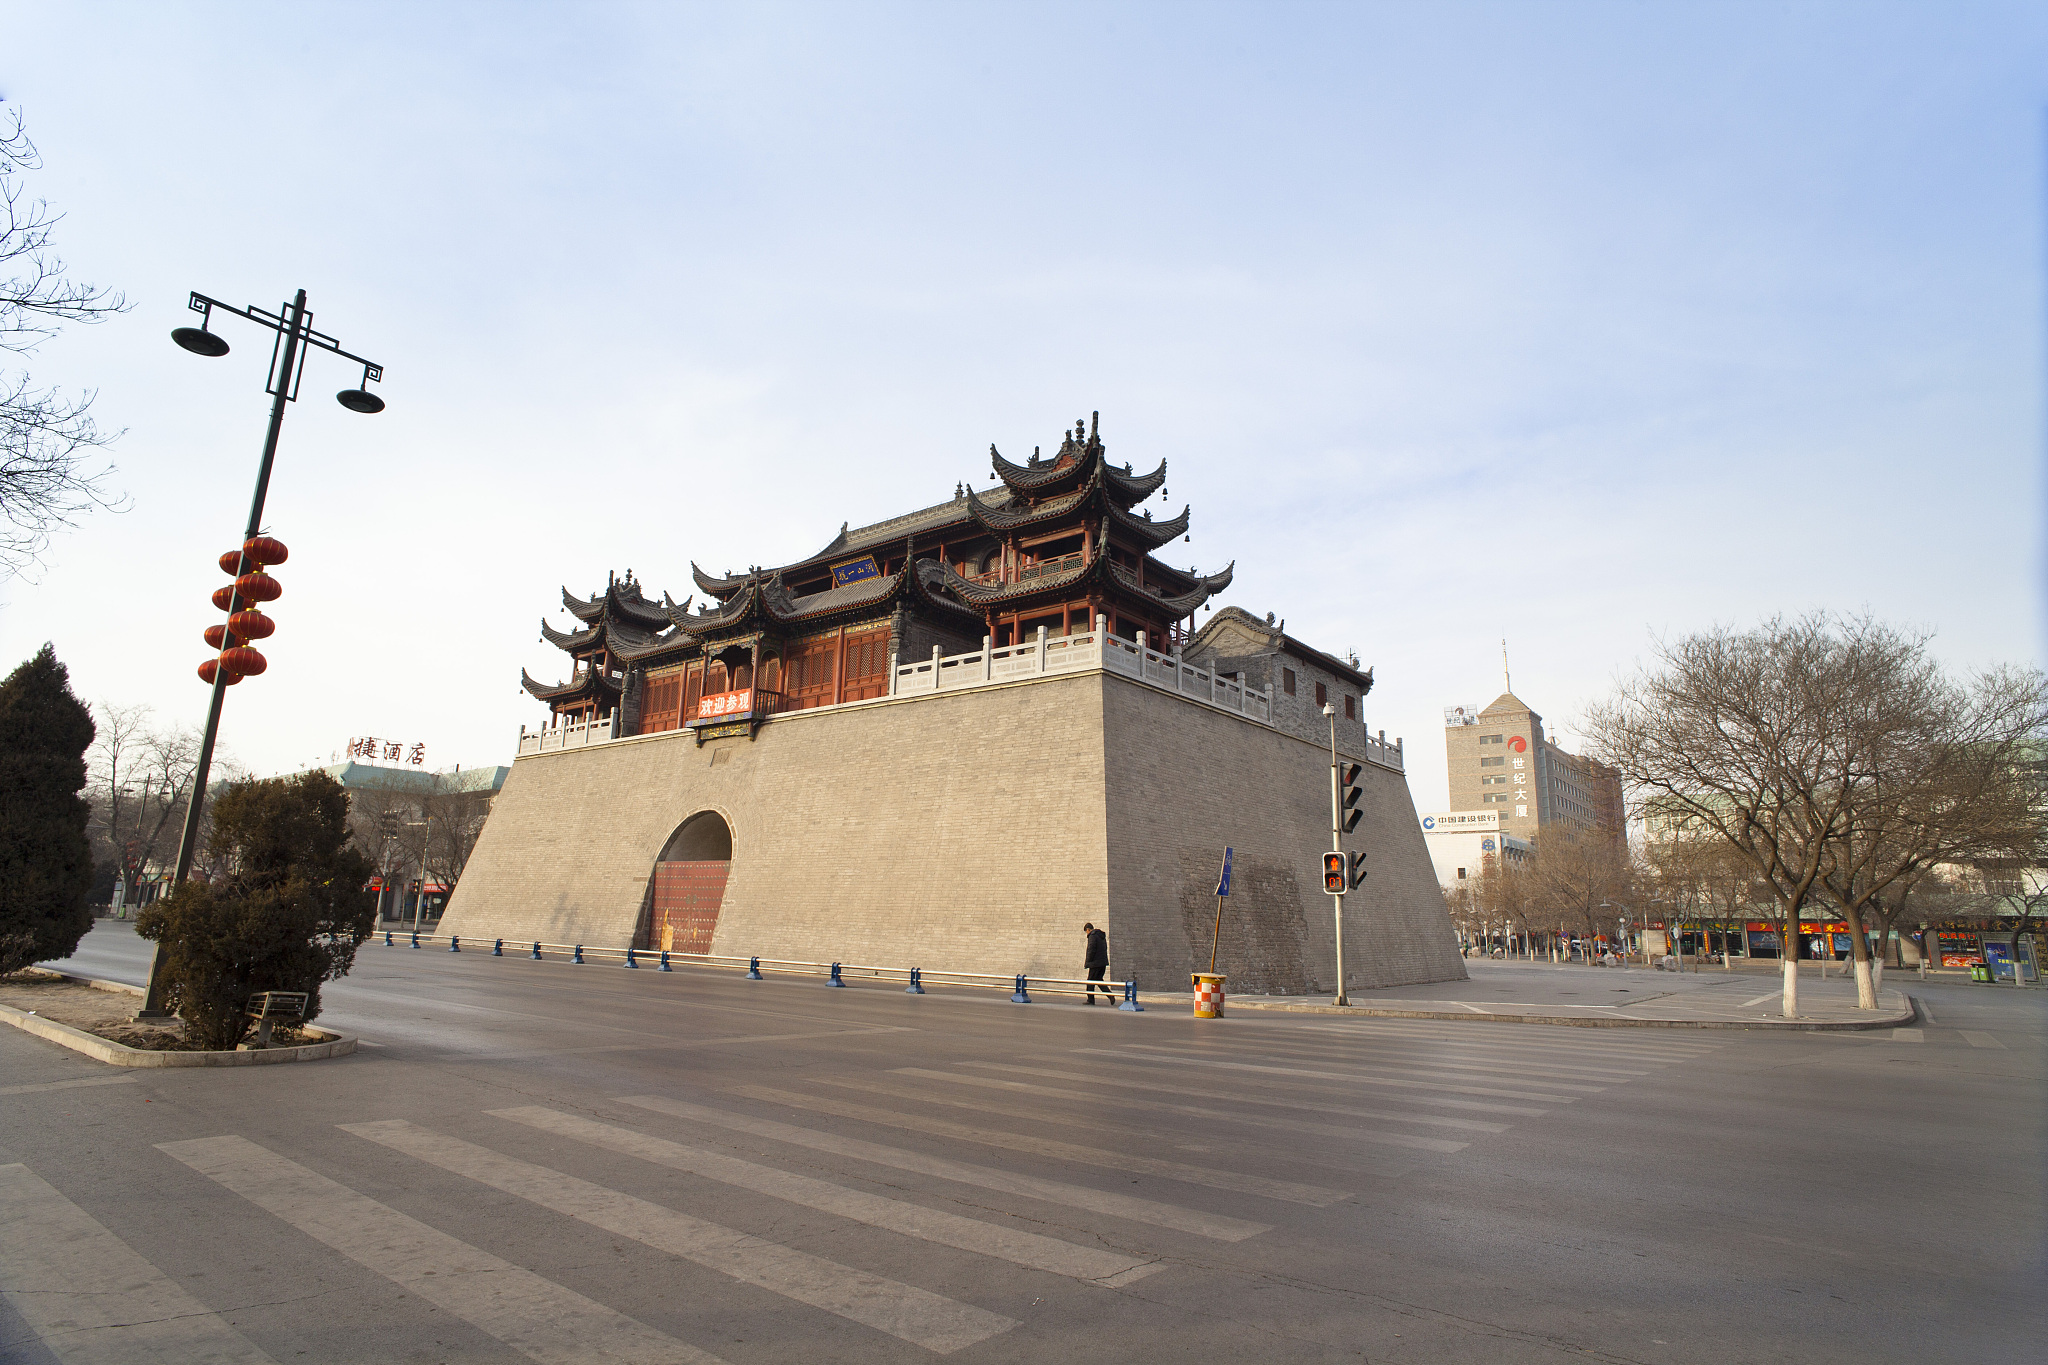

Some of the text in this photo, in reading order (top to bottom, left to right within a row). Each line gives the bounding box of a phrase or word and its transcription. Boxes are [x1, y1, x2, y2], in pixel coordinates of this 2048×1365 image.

[699, 691, 749, 716] 欢迎参观
[1512, 757, 1528, 817] 世纪大厦
[1438, 814, 1496, 823] 中国建设银行
[1329, 876, 1342, 888] 07
